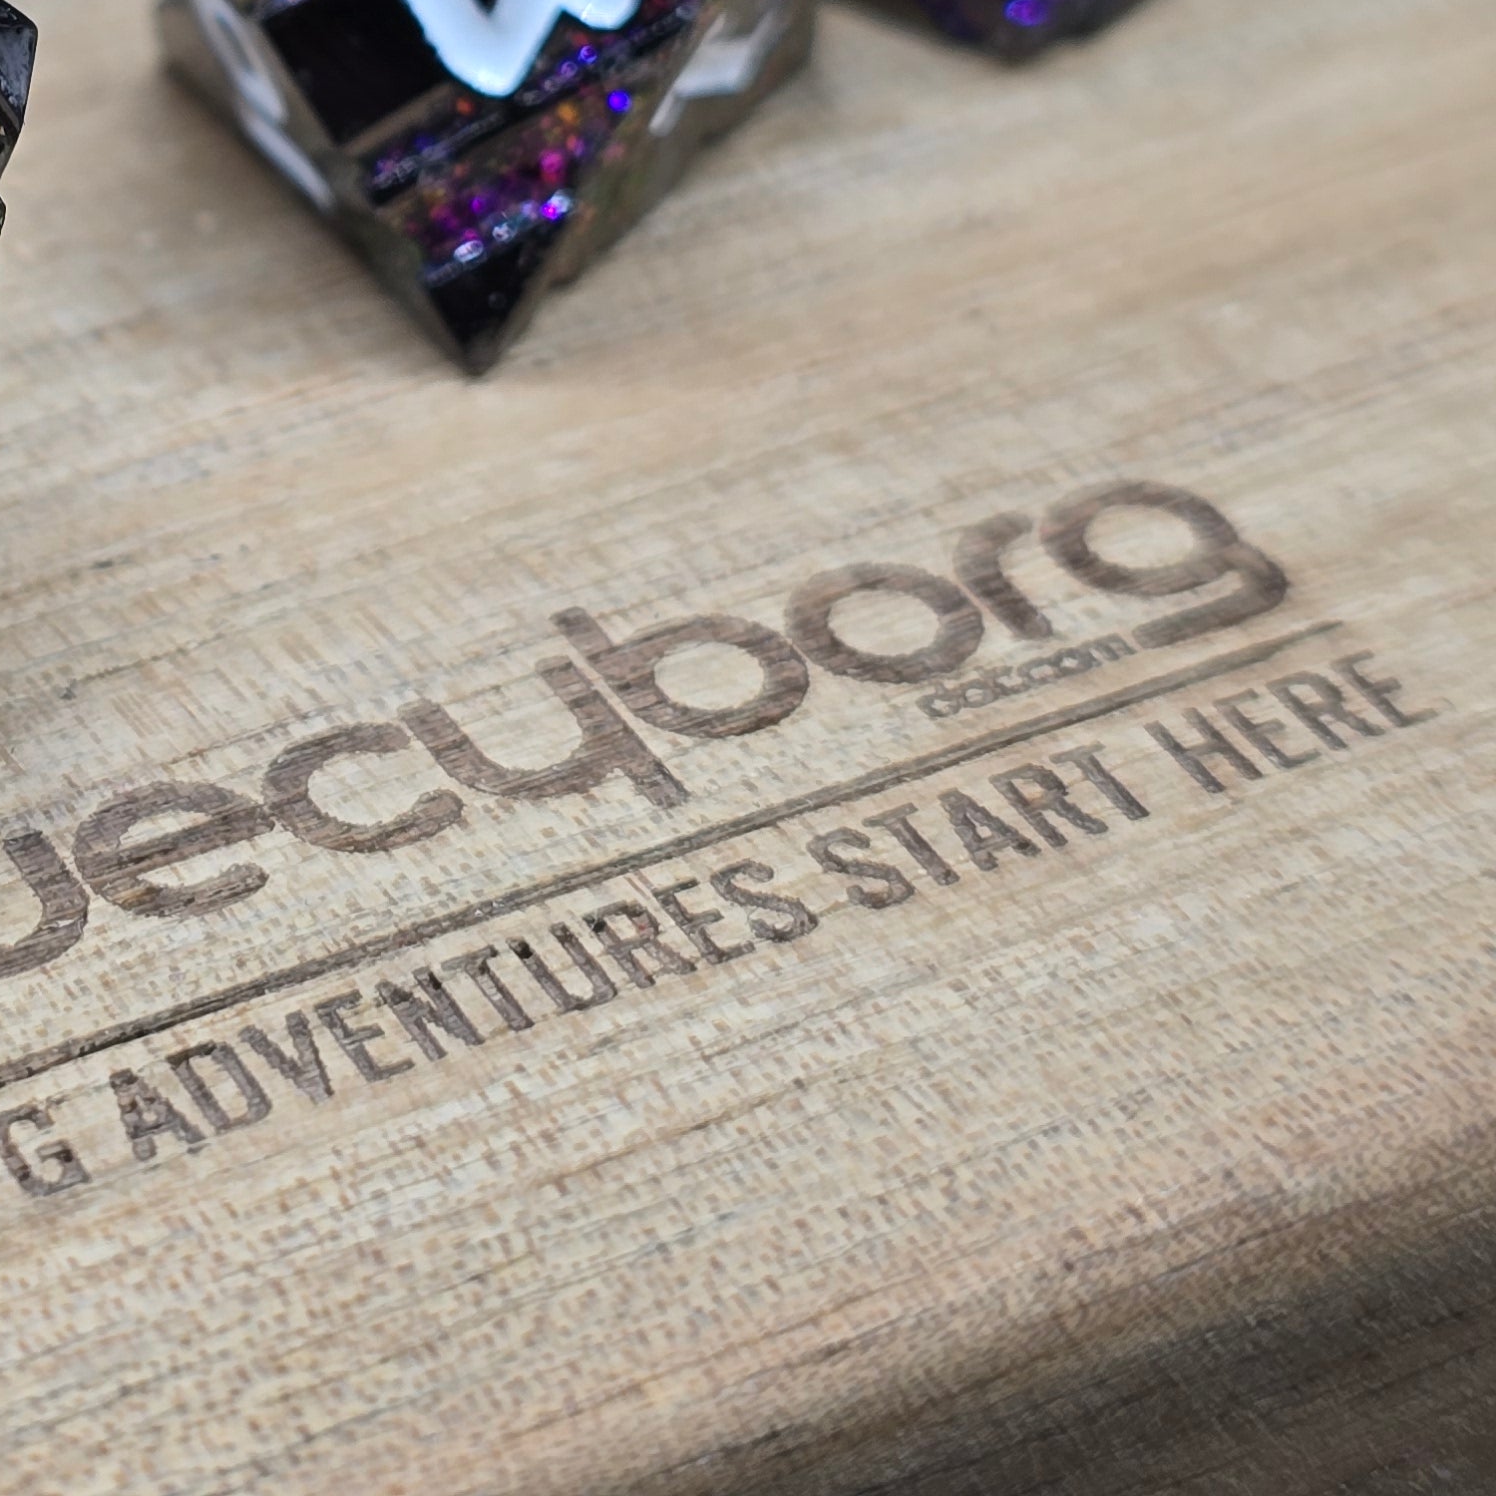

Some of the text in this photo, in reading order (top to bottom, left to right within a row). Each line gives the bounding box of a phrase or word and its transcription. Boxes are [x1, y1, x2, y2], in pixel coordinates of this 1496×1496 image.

[107, 857, 819, 1163] ADVENTURES
[806, 740, 1152, 911] START
[1142, 649, 1442, 795] HERE
